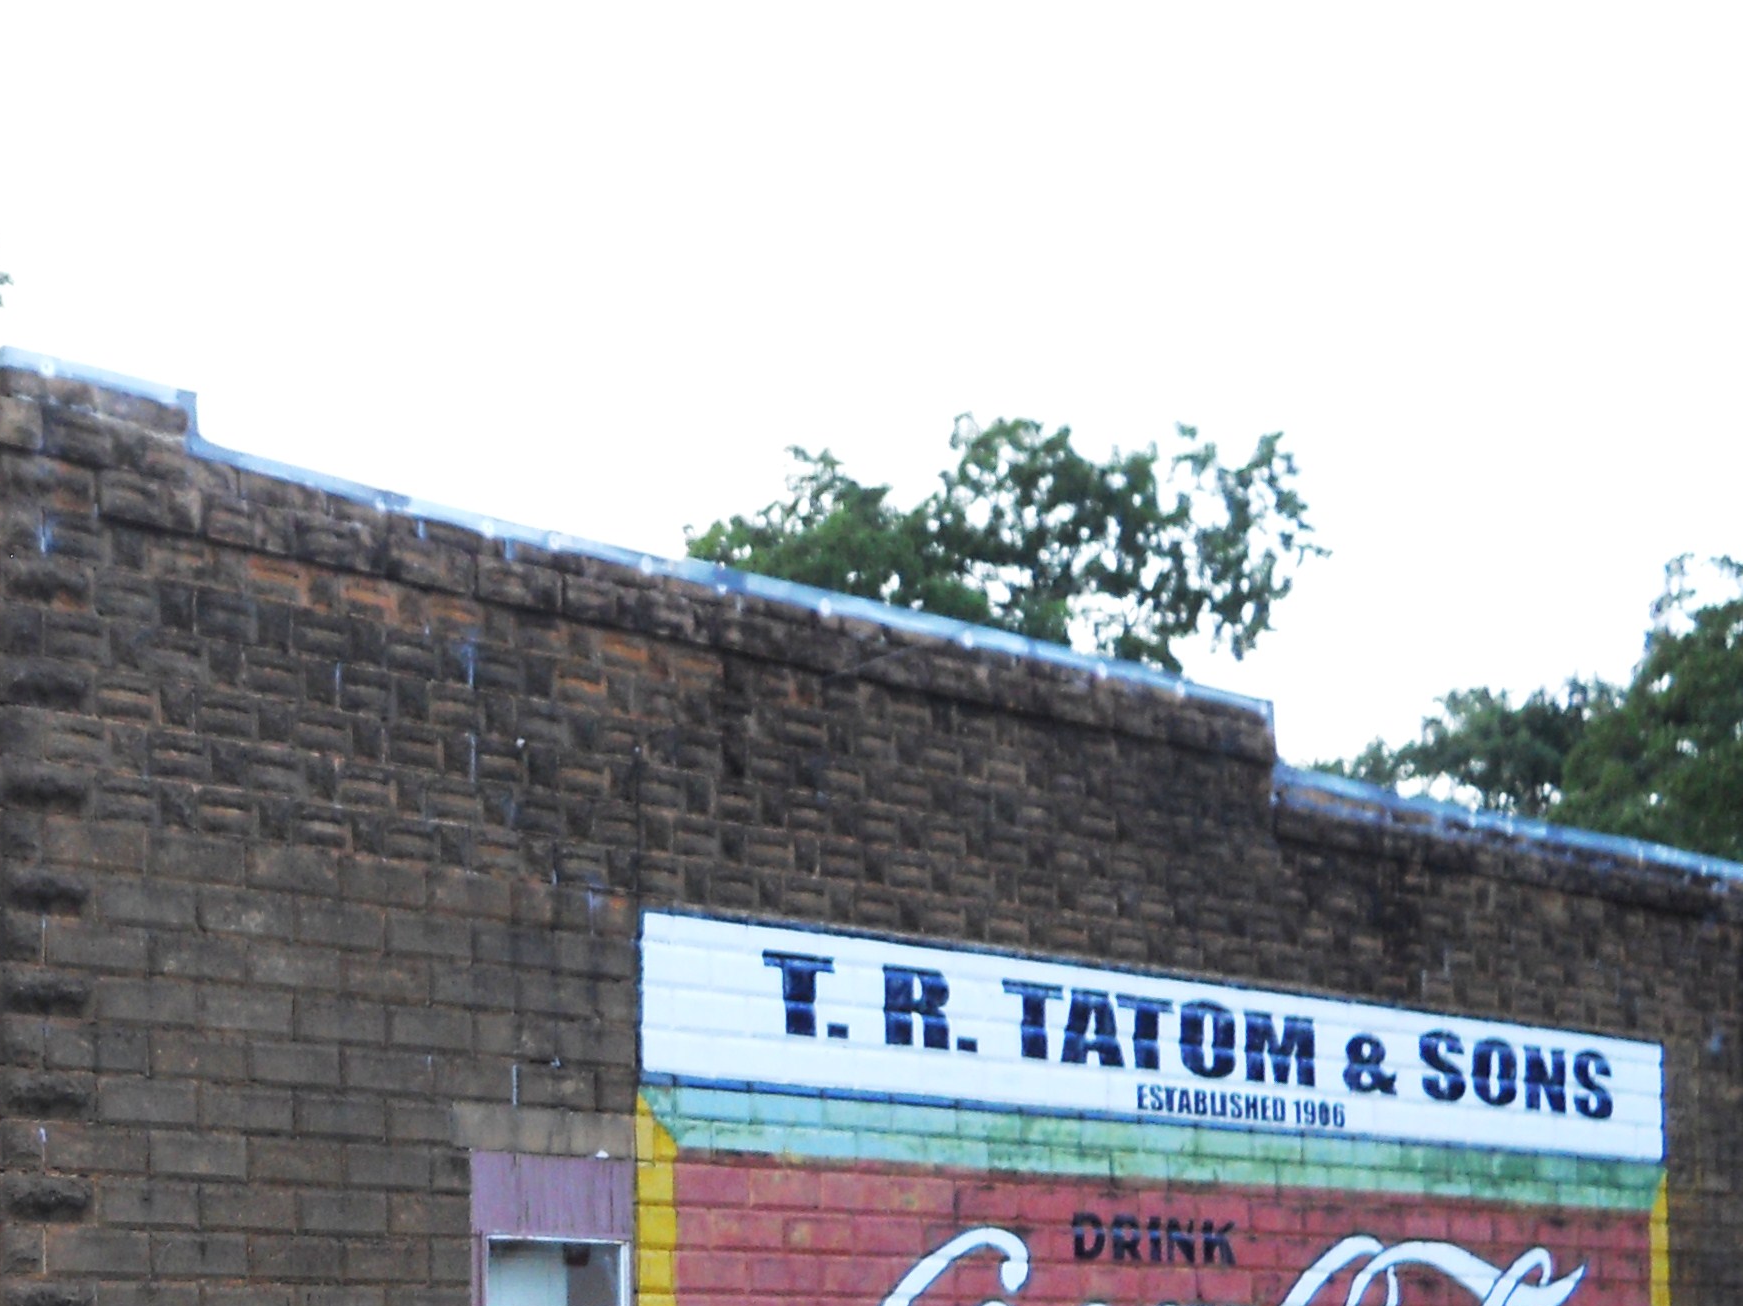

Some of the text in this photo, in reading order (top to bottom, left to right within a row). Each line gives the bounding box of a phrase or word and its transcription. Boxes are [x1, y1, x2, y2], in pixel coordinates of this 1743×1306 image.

[762, 949, 1614, 1119] T. R. TATOM & SONS
[1137, 1083, 1346, 1128] ESTABLISHED 1906
[1072, 1211, 1238, 1266] DRINK
